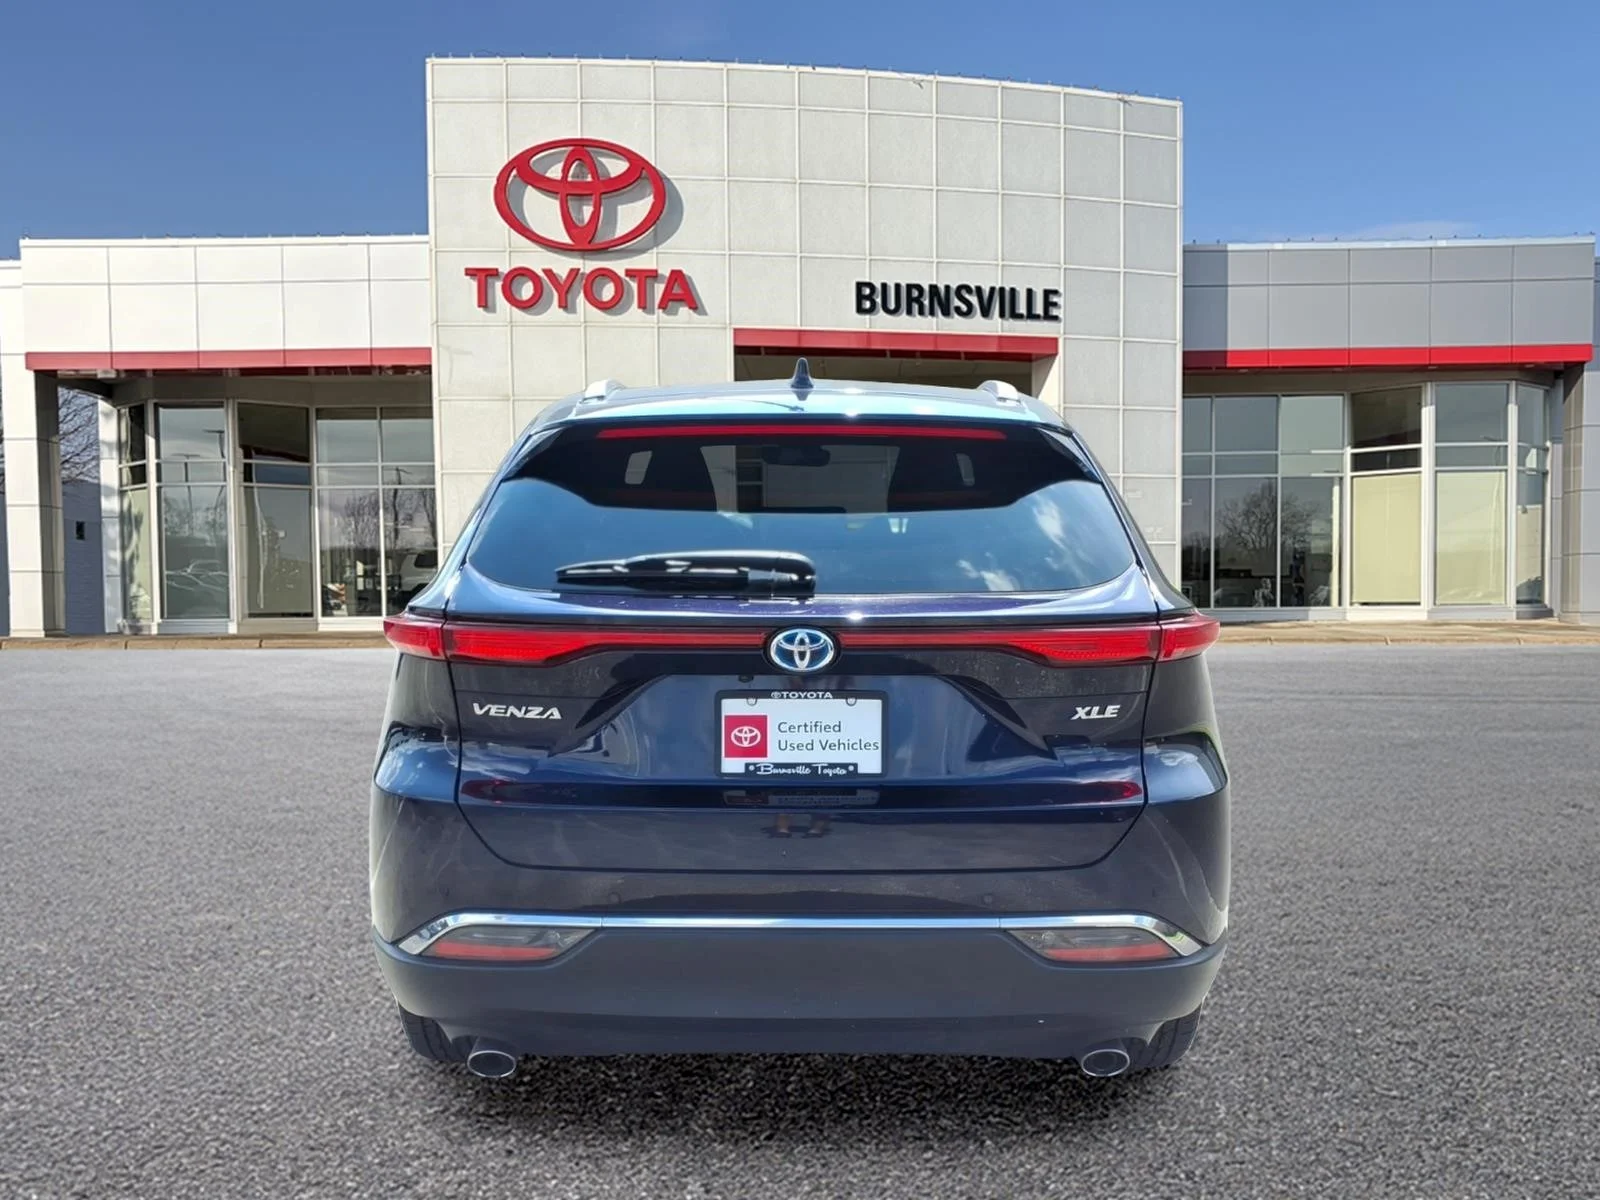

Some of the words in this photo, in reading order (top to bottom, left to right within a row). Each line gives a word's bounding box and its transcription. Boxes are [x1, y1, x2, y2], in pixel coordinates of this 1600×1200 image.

[464, 266, 699, 310] TOYOTA
[855, 281, 1061, 321] BURNSVILLE
[781, 691, 833, 699] TOYOTA
[472, 702, 562, 719] VENZA
[1070, 704, 1121, 720] XLE
[777, 721, 842, 733] Certified
[777, 739, 814, 751] Used
[819, 739, 879, 751] Vehicles
[755, 763, 811, 775] Burnsville
[812, 763, 847, 777] Toyota
